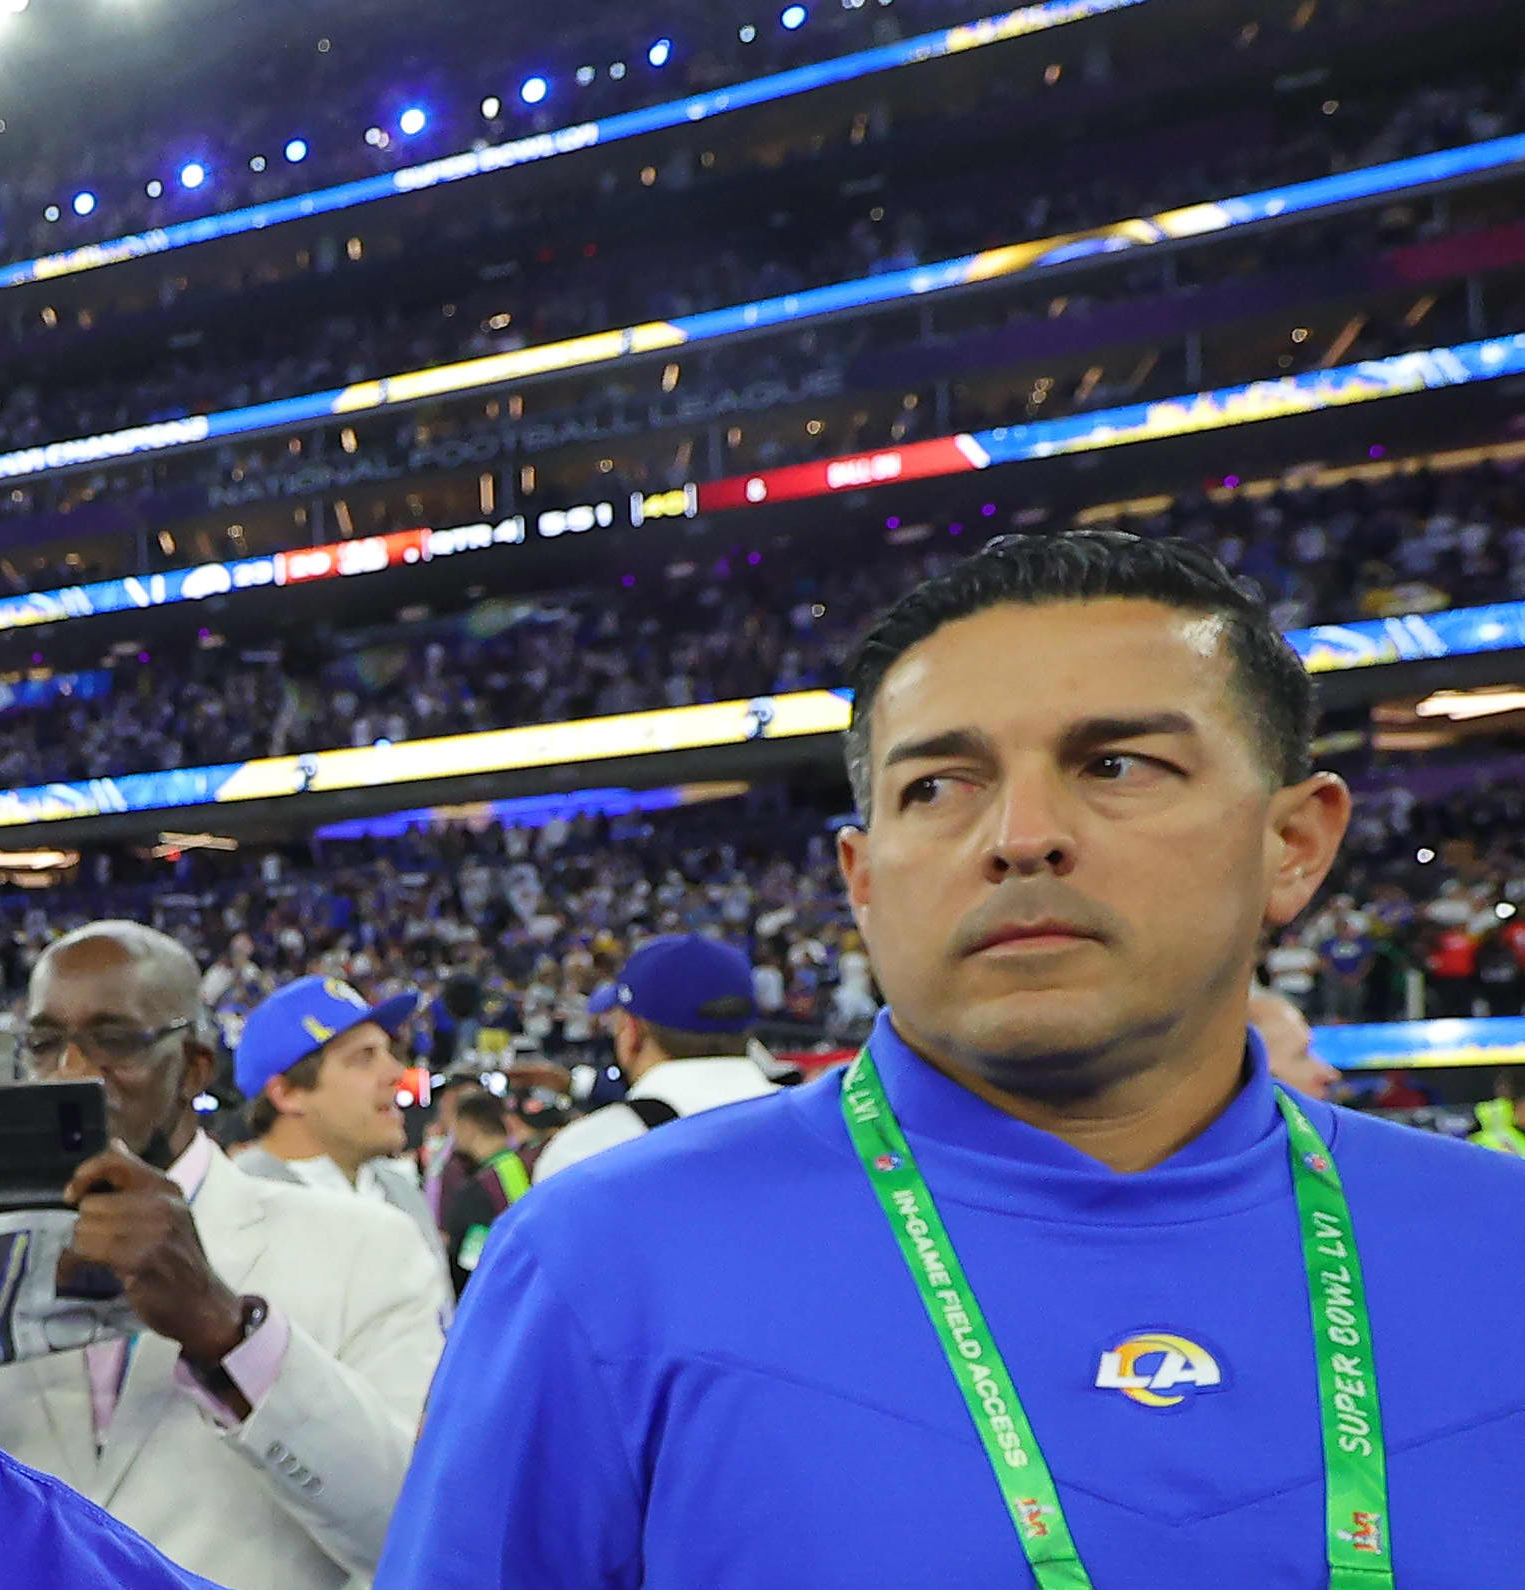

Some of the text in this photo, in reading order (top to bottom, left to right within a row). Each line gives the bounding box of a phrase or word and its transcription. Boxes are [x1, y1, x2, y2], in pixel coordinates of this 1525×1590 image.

[407, 405, 645, 468] FOOTBALL
[649, 367, 844, 428] LEAGUE
[1313, 1211, 1348, 1257] LVI
[892, 1189, 1028, 1469] IN-GAME FIELD ACCESS
[1321, 1266, 1361, 1346] BOWL
[1095, 1333, 1222, 1398] LA
[1331, 1352, 1372, 1457] SUPER
